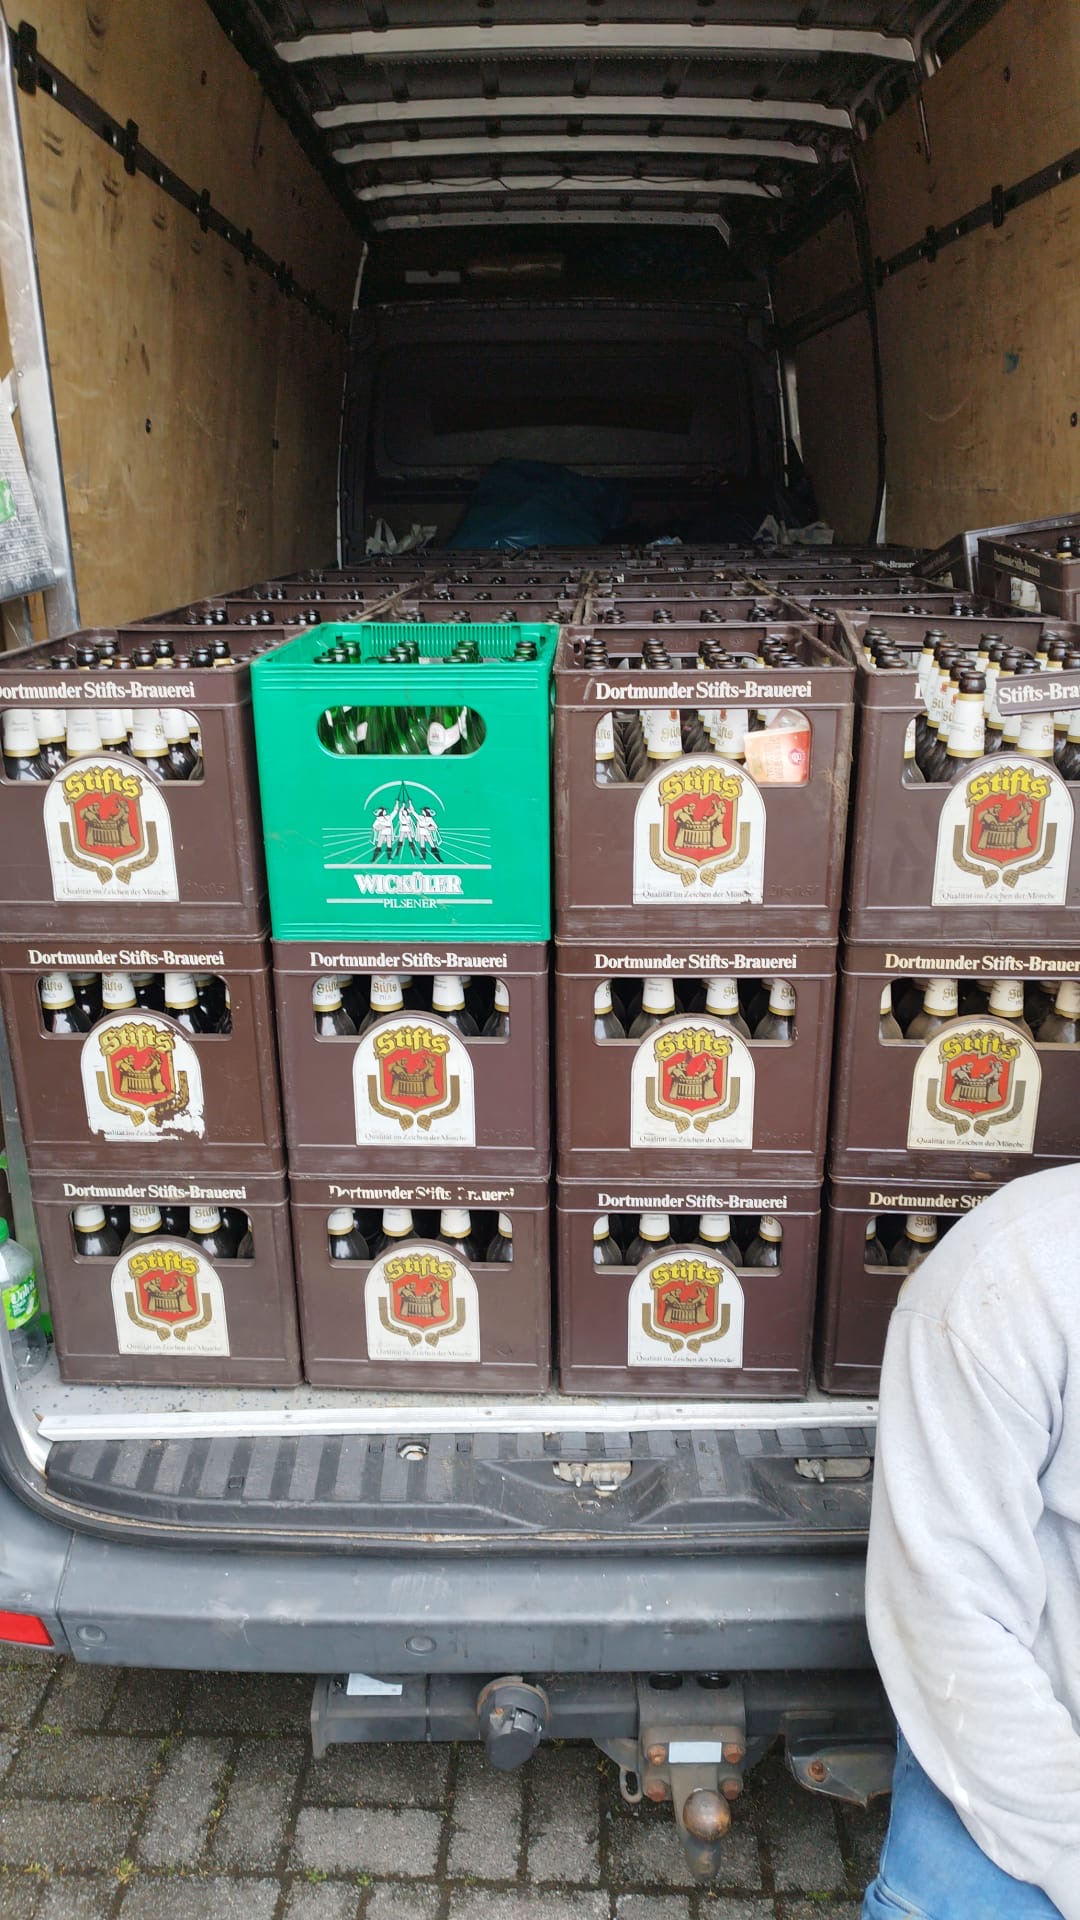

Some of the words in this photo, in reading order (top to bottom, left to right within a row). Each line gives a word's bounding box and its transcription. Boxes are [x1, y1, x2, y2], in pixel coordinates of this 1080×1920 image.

[84, 681, 196, 699] Stifts-Brauerei
[595, 681, 694, 700] Dortmunder
[696, 680, 812, 698] Stifts-Brauerei
[999, 682, 1080, 705] Stifts-Bra
[64, 767, 141, 802] Stifts
[661, 767, 741, 801] Stifts
[967, 768, 1049, 802] Stifts
[354, 872, 464, 895] WICKÜLER
[383, 898, 438, 909] PILSENER
[28, 949, 117, 965] Dortmunder
[119, 949, 225, 965] Stifts-Brauerei
[310, 951, 400, 967] Dortmunder
[402, 952, 507, 968] Stifts-Brauerei
[594, 953, 687, 968] Dortmunder
[689, 953, 797, 969] Stifts-Brauerei
[885, 953, 980, 970] Dortmunder
[101, 1024, 174, 1049] Stifts
[375, 1027, 449, 1055] Stifts
[656, 1030, 731, 1058] Stifts
[942, 1034, 1019, 1060] Stifts
[63, 1184, 146, 1198] Dortmunder
[147, 1185, 247, 1199] Stifts-Brauerei
[598, 1193, 684, 1208] Dortmunder
[686, 1194, 787, 1208] Stifts-Brauerei
[870, 1192, 959, 1208] Dortmunder
[130, 1251, 198, 1276] Stifts
[386, 1255, 454, 1281] Stifts
[651, 1261, 722, 1287] Stifts
